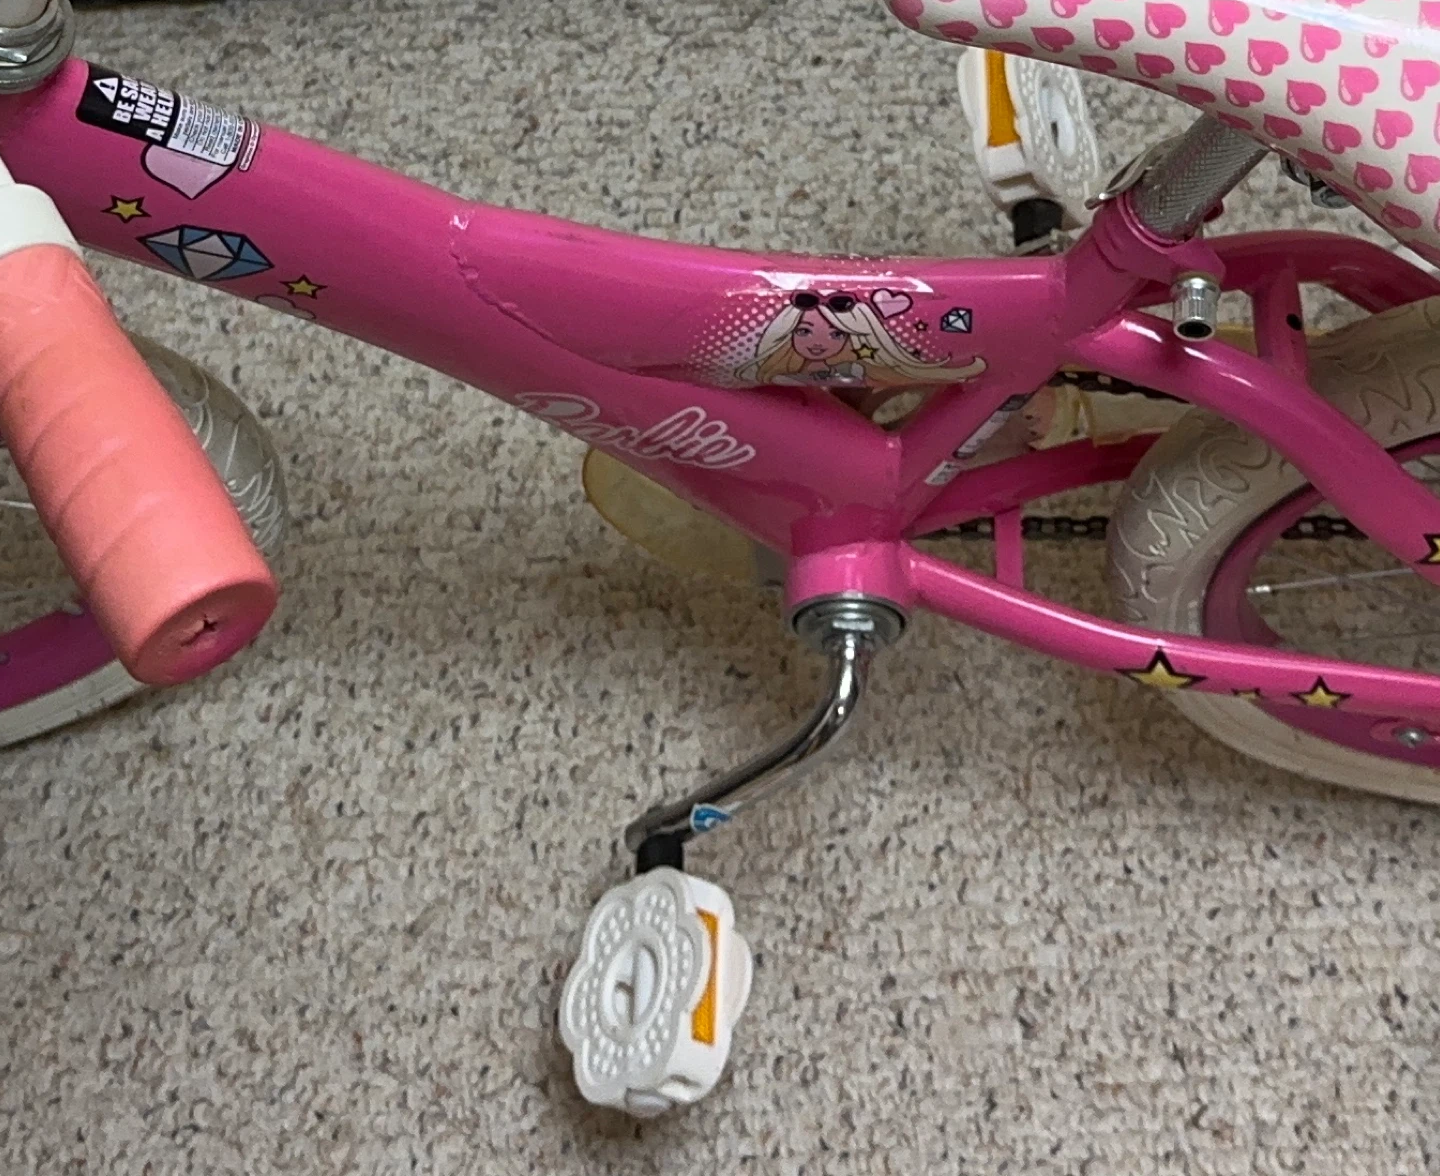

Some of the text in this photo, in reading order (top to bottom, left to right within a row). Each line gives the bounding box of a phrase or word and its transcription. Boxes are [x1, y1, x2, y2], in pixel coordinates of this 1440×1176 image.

[112, 74, 139, 124] BE SA
[146, 128, 164, 141] A
